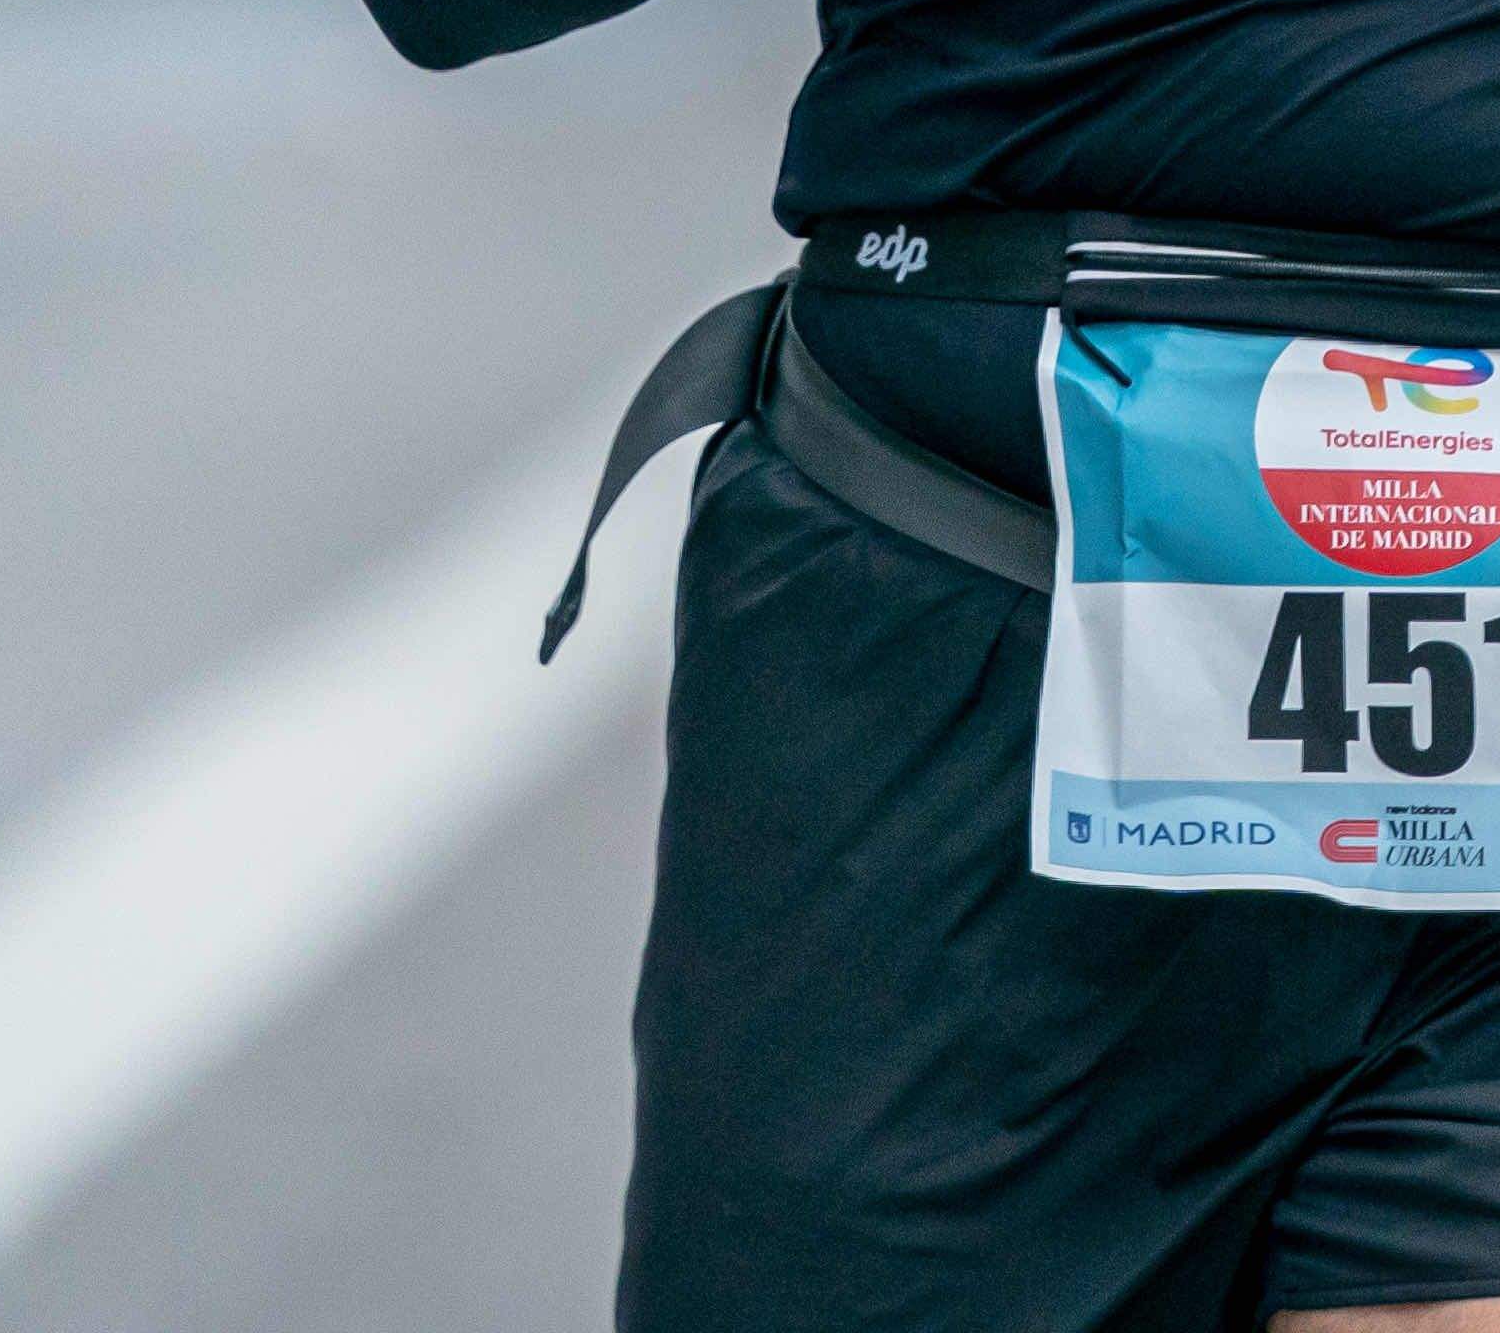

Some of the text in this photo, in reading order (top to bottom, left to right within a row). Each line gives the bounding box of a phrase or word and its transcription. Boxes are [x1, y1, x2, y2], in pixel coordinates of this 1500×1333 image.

[856, 223, 929, 284] edp
[1320, 428, 1494, 455] TotalEnergies
[1362, 479, 1444, 500] MILLA
[1330, 529, 1474, 551] DE MADRID
[1385, 805, 1410, 815] new
[1117, 820, 1277, 847] MADRID
[1386, 819, 1477, 842] MILLA
[1384, 845, 1488, 868] URBANA
